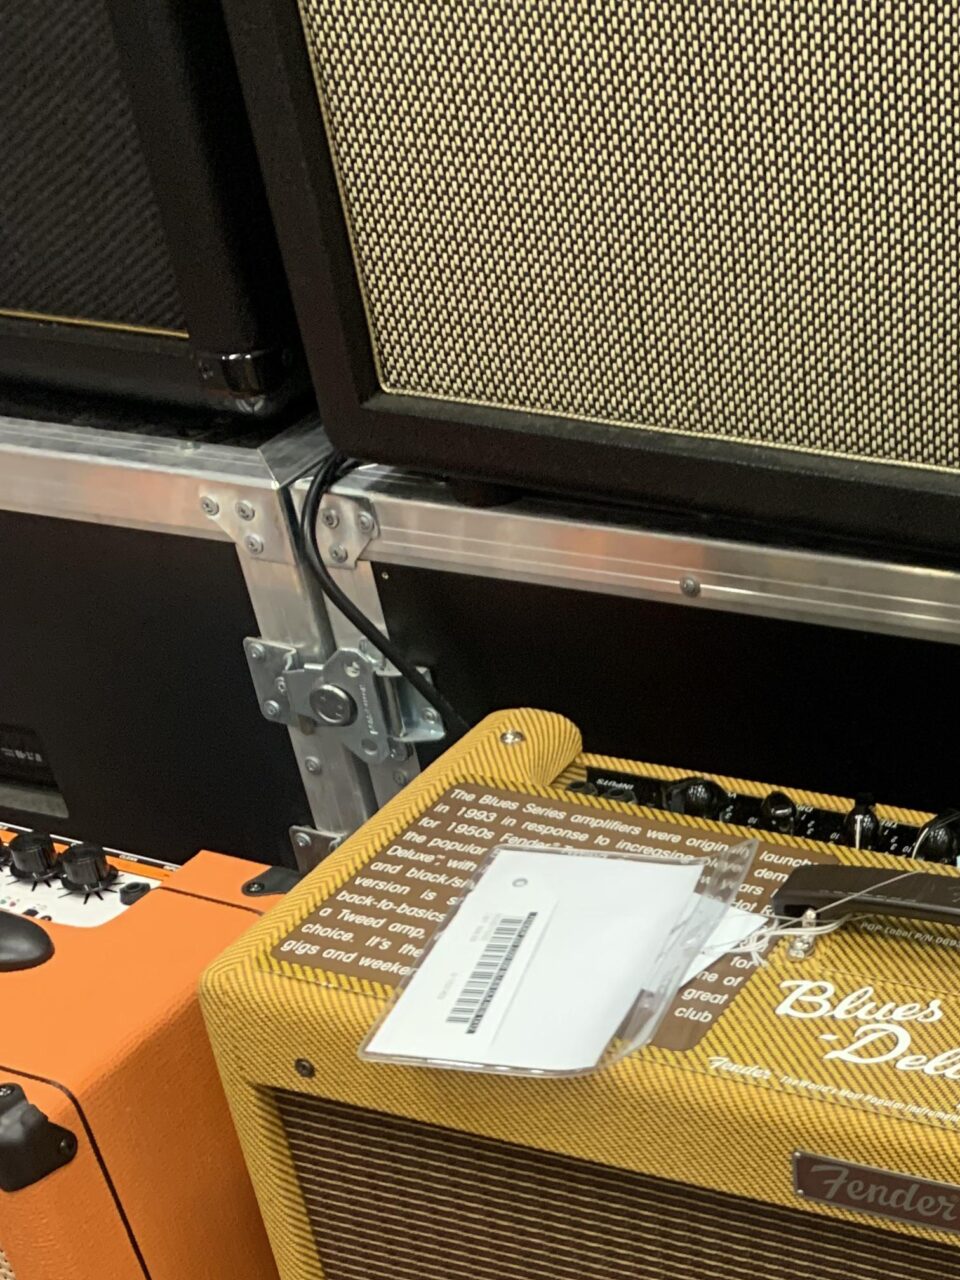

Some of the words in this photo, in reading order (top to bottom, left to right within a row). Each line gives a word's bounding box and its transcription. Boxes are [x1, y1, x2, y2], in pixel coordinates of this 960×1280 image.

[596, 778, 634, 790] INPUTS
[402, 831, 428, 844] the
[427, 837, 489, 857] popular
[418, 816, 442, 829] for
[447, 821, 495, 841] 1950s
[433, 802, 450, 814] in
[456, 806, 498, 823] 1993
[500, 816, 517, 828] in
[521, 820, 590, 843] response
[594, 834, 610, 847] to
[616, 838, 695, 864] increasing
[450, 788, 476, 802] The
[478, 794, 520, 811] Blues
[522, 802, 567, 820] Series
[570, 813, 642, 836] amplifiers
[646, 829, 682, 844] were
[759, 850, 818, 866] launch
[370, 861, 403, 875] and
[446, 859, 479, 872] with
[336, 889, 448, 923] back-to-basics
[696, 970, 719, 982] ne
[722, 975, 744, 988] of
[354, 877, 411, 896] version
[420, 889, 438, 901] is
[730, 956, 753, 969] for
[884, 926, 912, 940] Label
[914, 931, 934, 943] P/N
[280, 938, 321, 955] gigs
[322, 948, 357, 963] and
[301, 920, 355, 943] choice.
[365, 936, 393, 951] It's
[398, 943, 425, 958] the
[674, 1006, 713, 1024] club
[319, 907, 333, 918] a
[337, 908, 387, 929] Tweed
[387, 920, 427, 940] amp,
[681, 986, 729, 1005] great
[775, 979, 944, 1023] Blues
[708, 1056, 772, 1080] Fender
[839, 1088, 865, 1100] Most
[864, 1093, 905, 1110] Popular
[905, 1103, 960, 1123] Instrument
[811, 1164, 960, 1221] Fender
